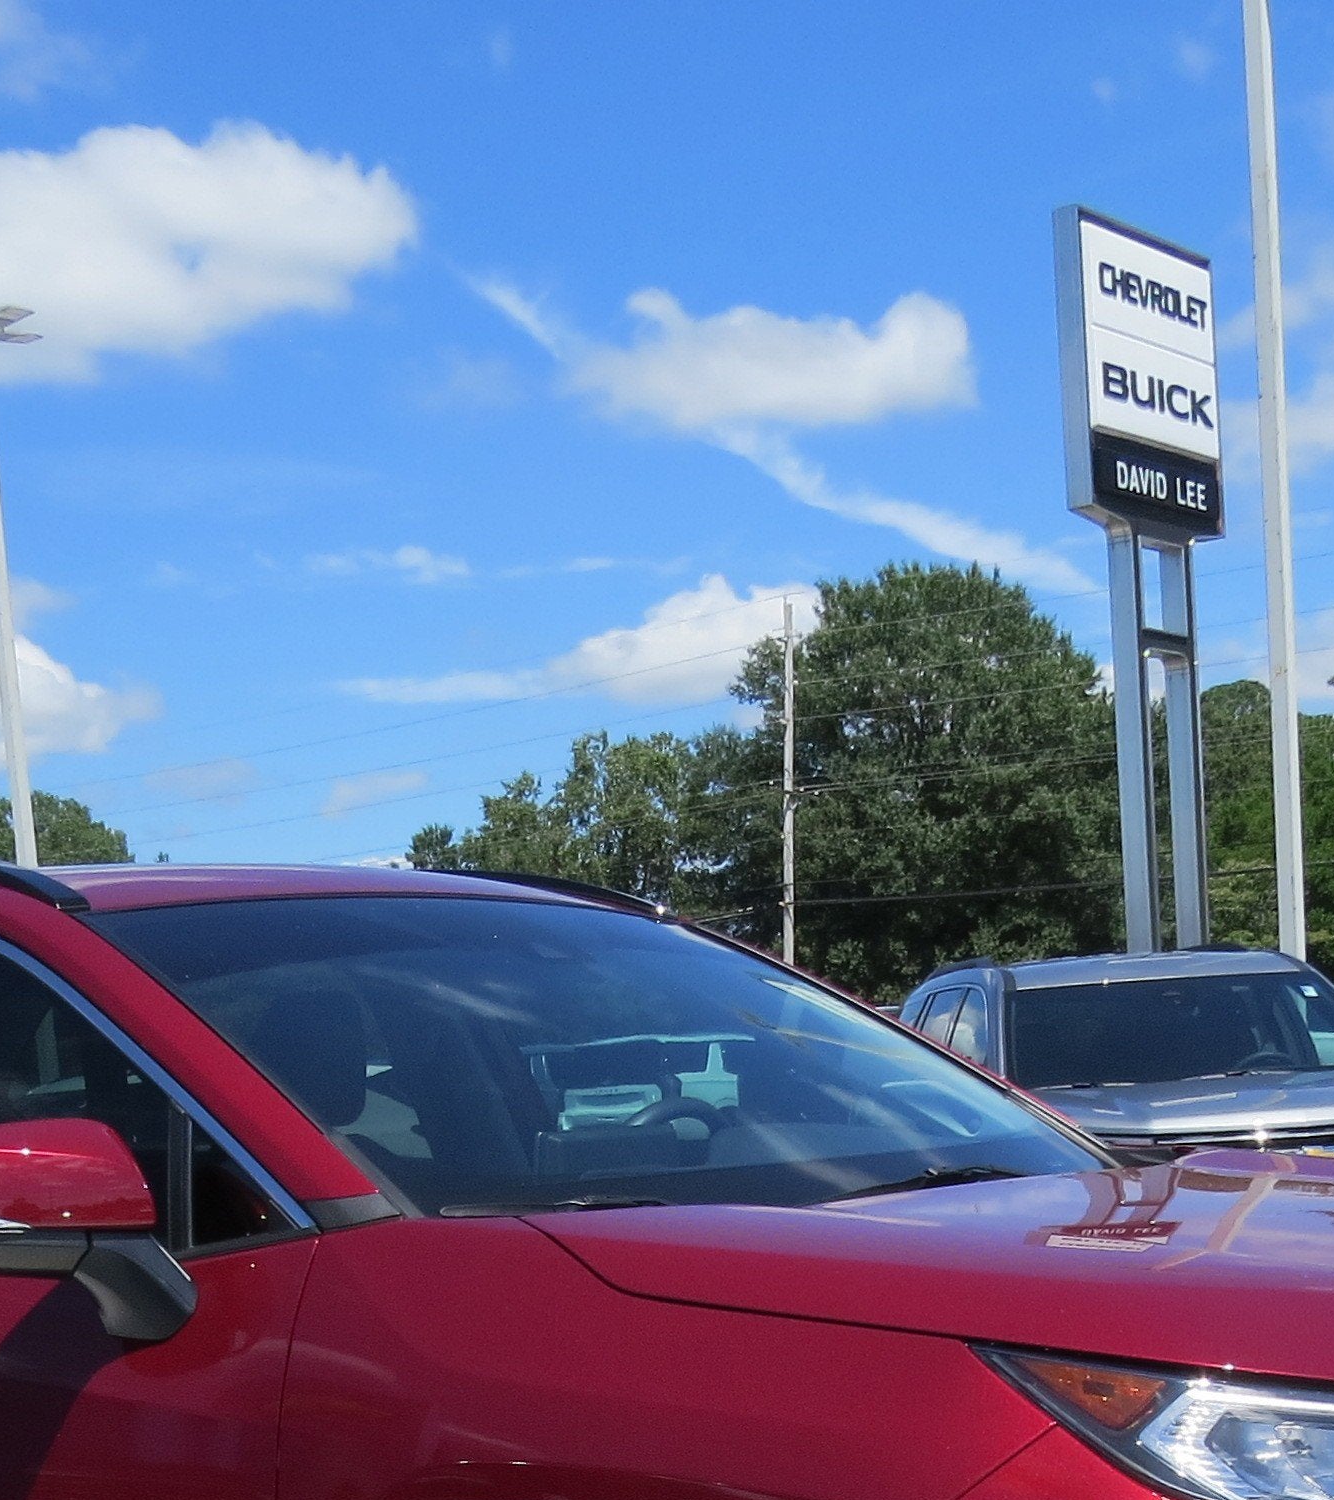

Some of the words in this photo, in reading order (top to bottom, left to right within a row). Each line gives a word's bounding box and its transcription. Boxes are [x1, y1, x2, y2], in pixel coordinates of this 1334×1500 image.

[1099, 262, 1207, 332] CHEVROLET
[1102, 361, 1214, 428] BUICK
[1116, 461, 1167, 500] DAVID
[1176, 478, 1207, 511] LEE
